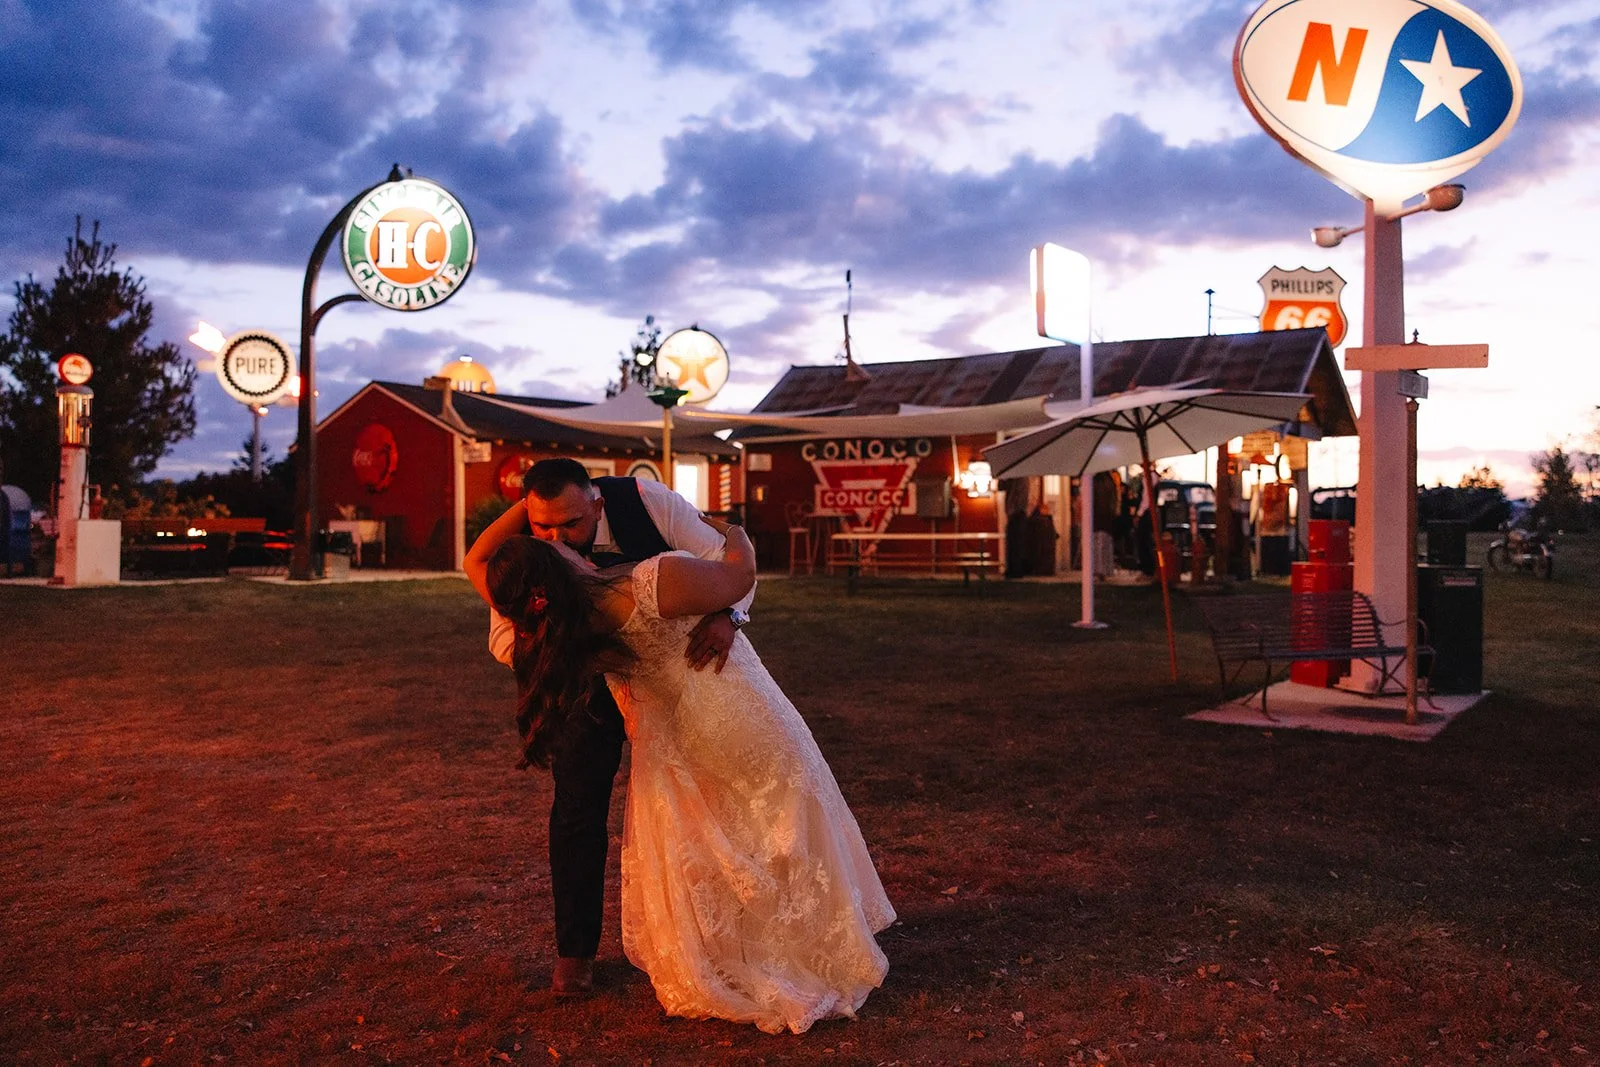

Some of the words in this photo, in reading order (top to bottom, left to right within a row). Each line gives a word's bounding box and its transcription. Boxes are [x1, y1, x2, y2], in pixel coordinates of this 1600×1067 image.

[1287, 21, 1369, 107] N
[352, 261, 464, 308] GASOLINE
[1271, 279, 1334, 295] PHILLIPS
[235, 357, 276, 375] PURE
[801, 439, 932, 461] CONOCO
